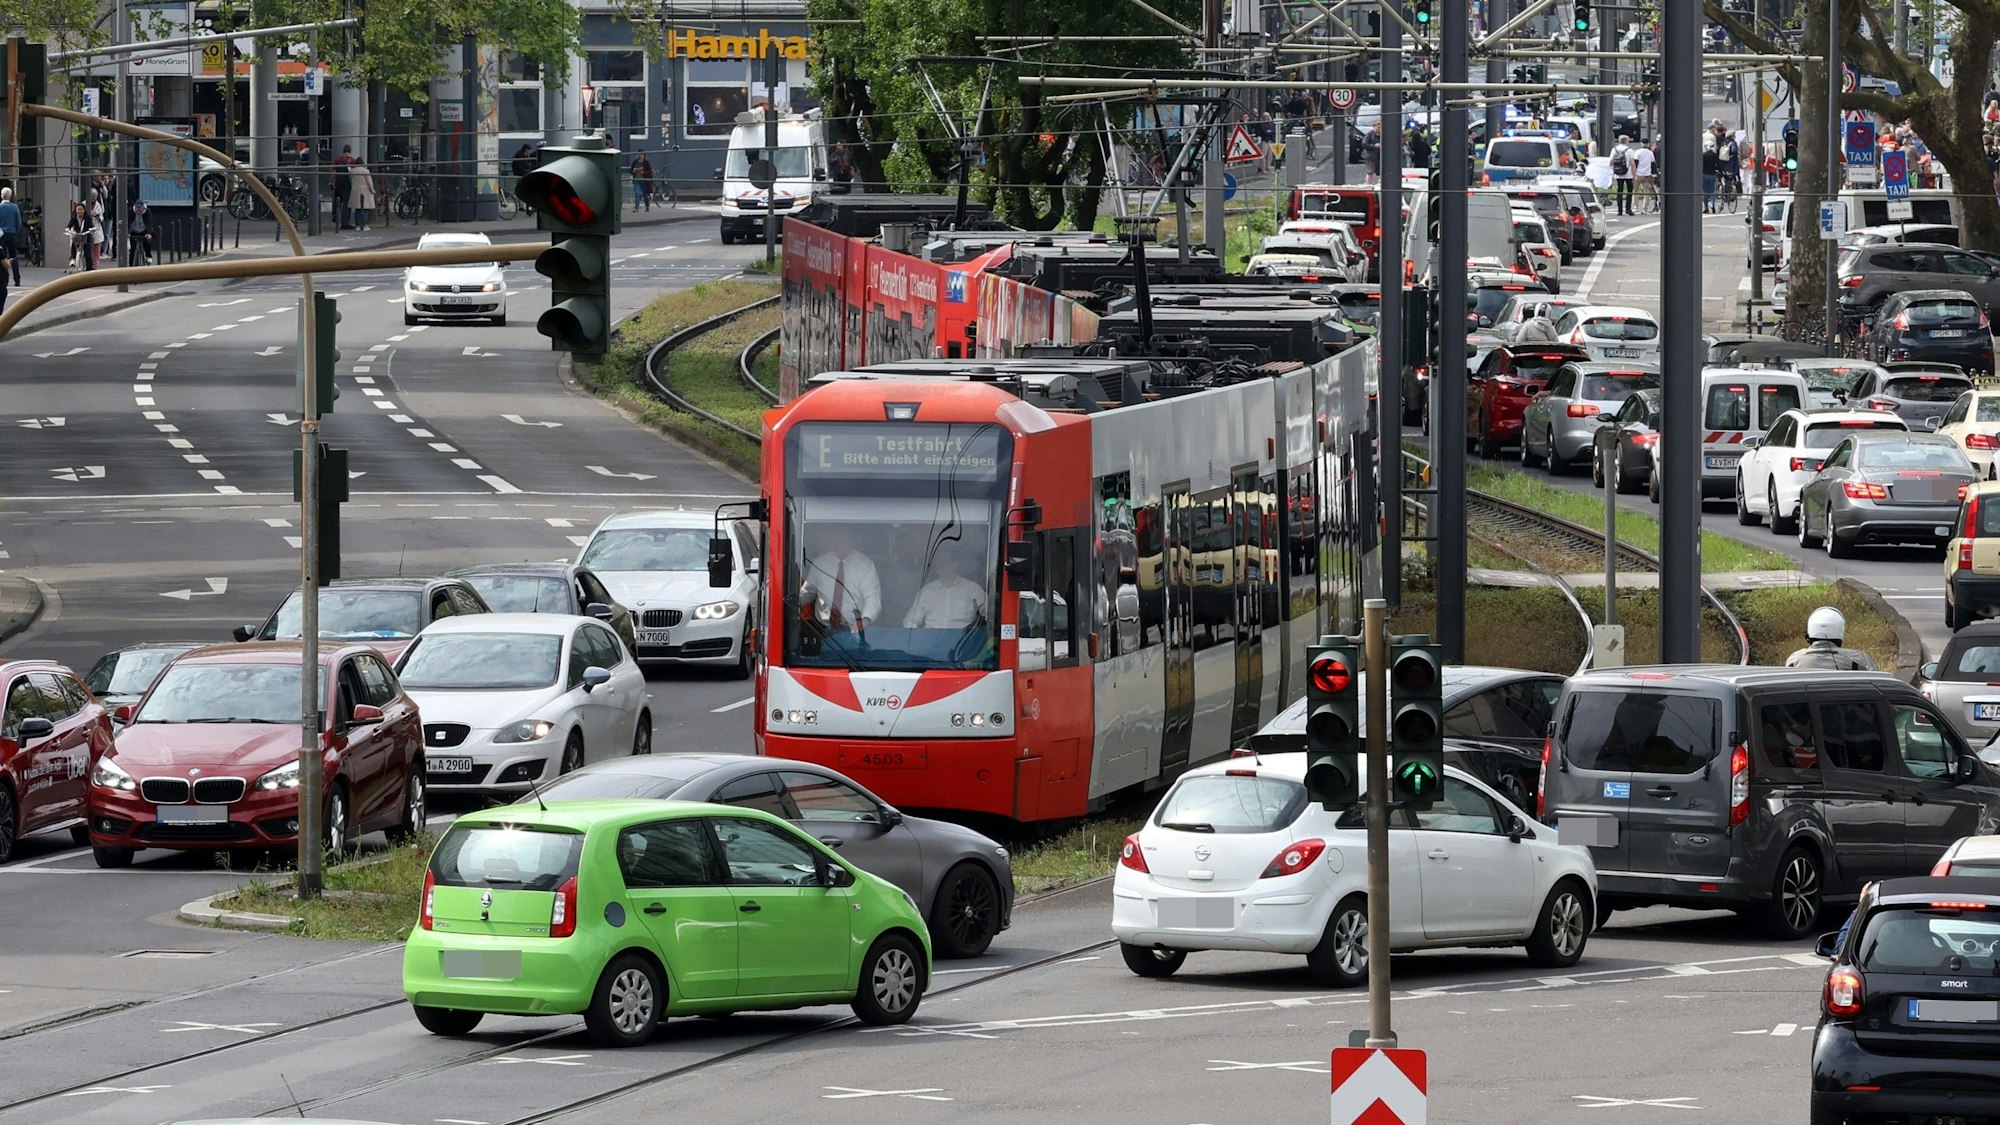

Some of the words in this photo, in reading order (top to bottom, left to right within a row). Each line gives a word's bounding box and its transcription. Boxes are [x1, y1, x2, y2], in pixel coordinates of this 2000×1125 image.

[668, 28, 816, 59] Hamha
[1335, 90, 1350, 101] 30
[1849, 151, 1872, 162] TAXI
[1888, 185, 1907, 195] TAXI
[876, 436, 963, 452] Testfahrt
[819, 435, 832, 468] E
[843, 453, 879, 465] Bitte
[884, 454, 919, 465] nicht
[924, 454, 996, 467] einsteigen
[647, 633, 668, 642] 7000
[866, 698, 887, 707] KVB
[863, 753, 904, 765] 4503
[67, 755, 87, 780] Uber
[446, 760, 470, 770] 2900
[1941, 980, 1968, 988] smart
